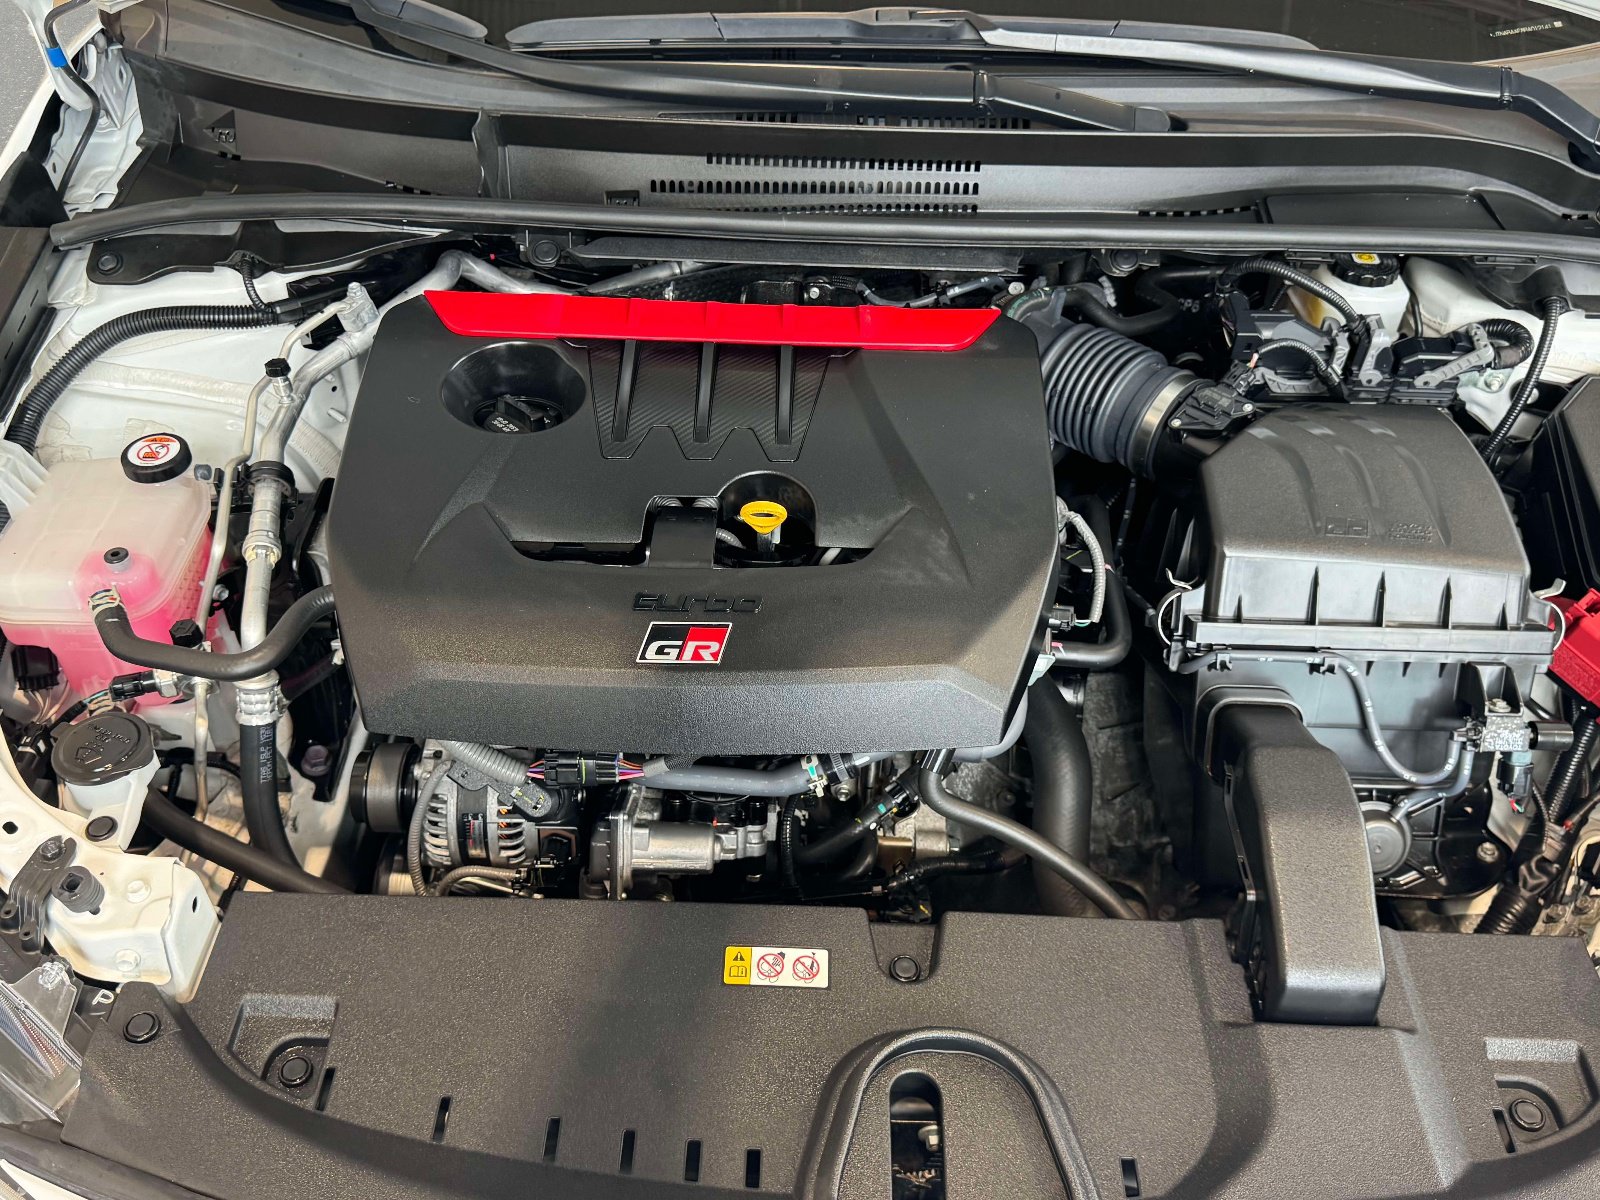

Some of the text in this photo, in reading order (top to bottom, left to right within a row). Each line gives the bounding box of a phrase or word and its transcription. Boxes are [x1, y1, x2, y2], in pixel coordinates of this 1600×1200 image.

[633, 592, 764, 613] turbo
[644, 640, 720, 661] GR
[91, 989, 115, 1005] P
